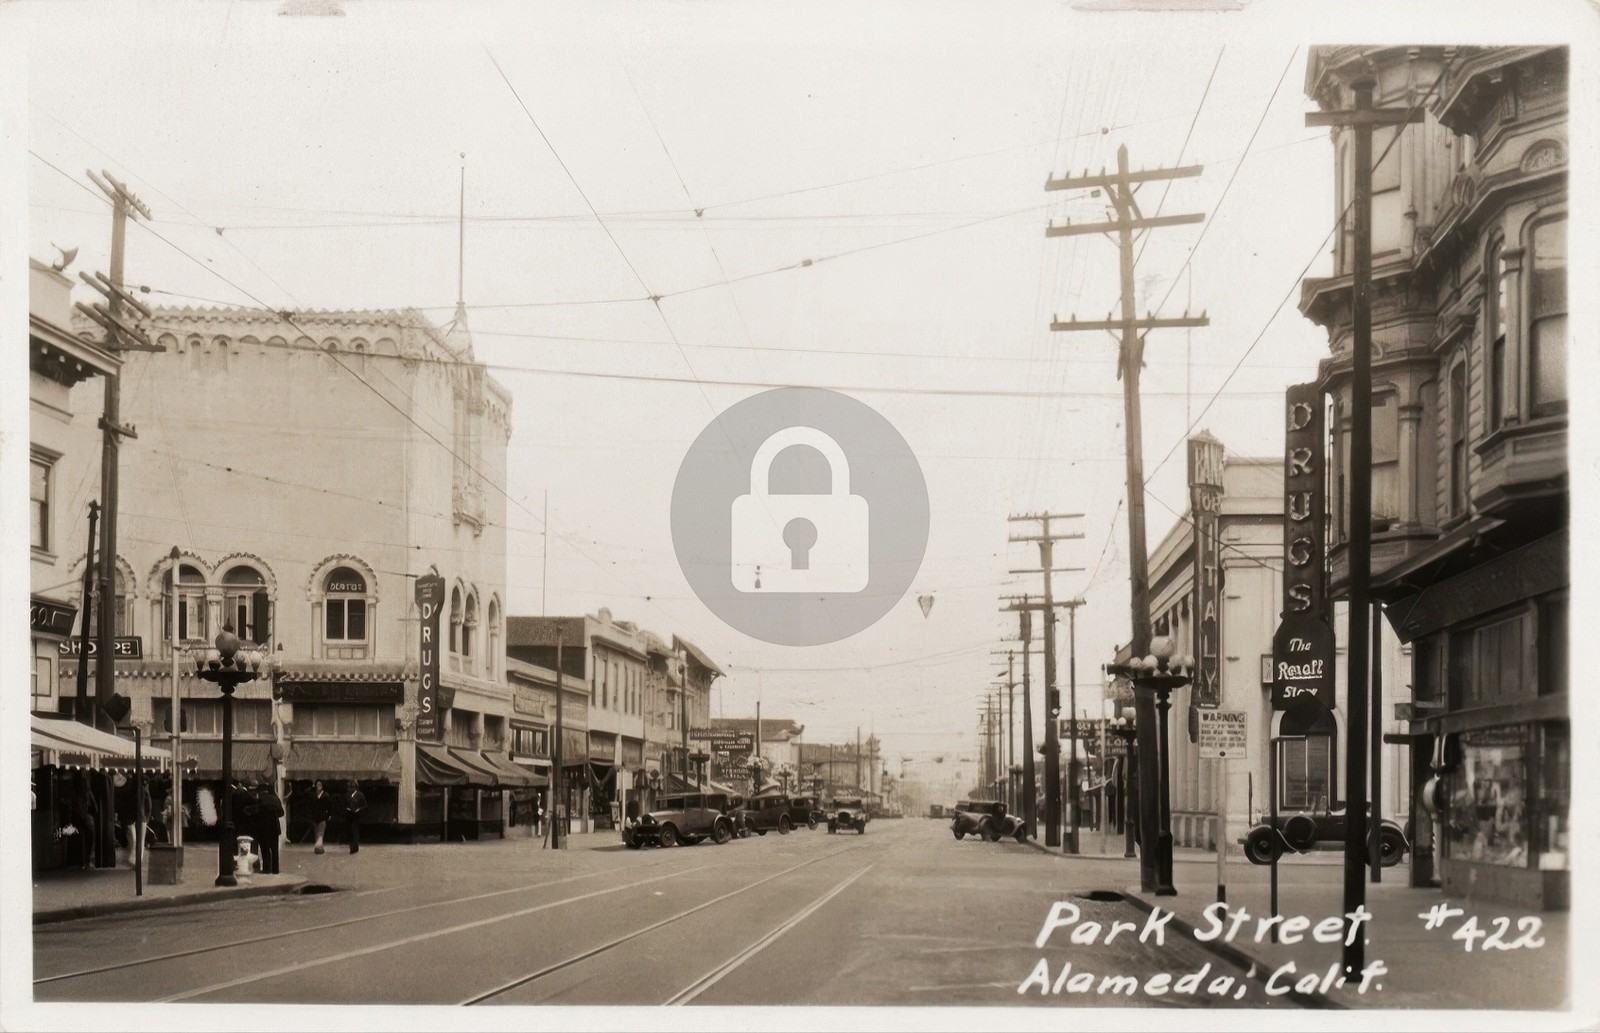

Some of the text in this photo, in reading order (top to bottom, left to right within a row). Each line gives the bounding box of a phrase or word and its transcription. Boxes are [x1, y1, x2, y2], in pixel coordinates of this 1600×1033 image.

[1286, 402, 1313, 612] DRUGS
[59, 641, 132, 655] SHOPE
[422, 602, 433, 714] DRUGS
[1202, 522, 1218, 694] ITALY
[1289, 637, 1312, 652] The
